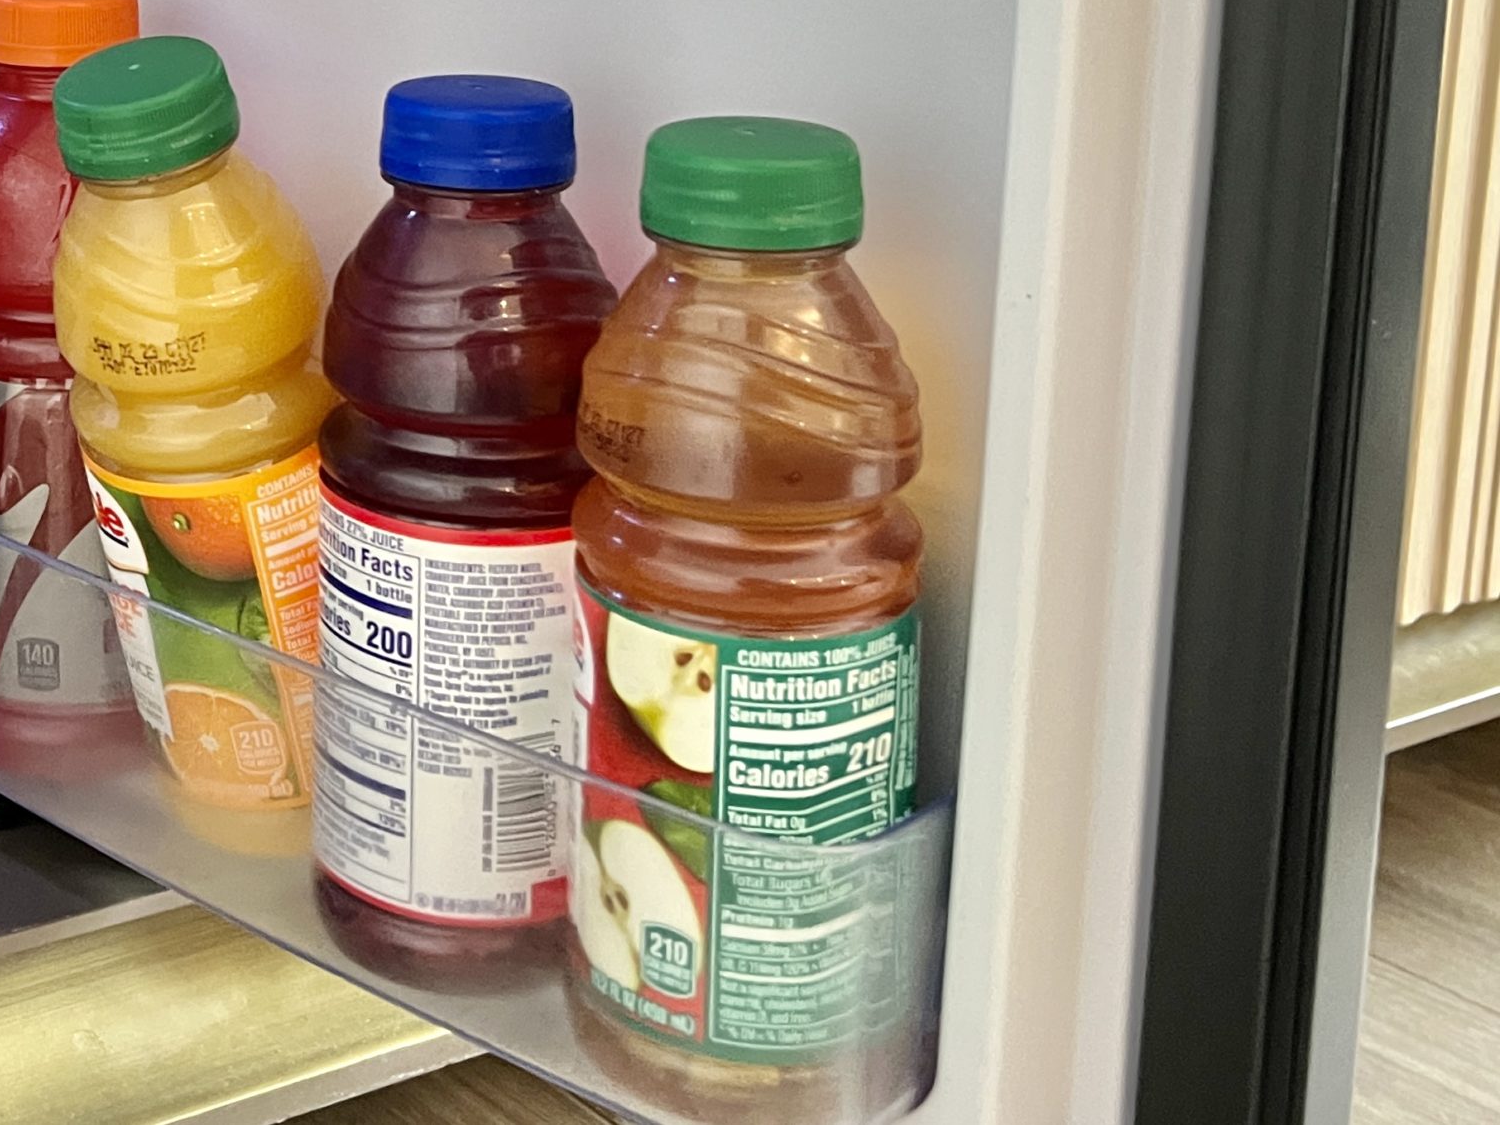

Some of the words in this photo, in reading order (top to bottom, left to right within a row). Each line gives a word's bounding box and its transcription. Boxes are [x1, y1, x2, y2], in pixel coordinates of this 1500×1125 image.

[257, 464, 314, 499] CONTAINS
[257, 482, 319, 525] Nutriti
[261, 517, 308, 544] Serving
[346, 520, 368, 540] 27%
[370, 531, 405, 552] JUICE
[361, 547, 414, 581] Facts
[366, 579, 372, 592] 1
[375, 581, 413, 604] bottle
[21, 644, 54, 665] 140
[366, 620, 413, 660] 200
[737, 649, 820, 668] CONTAINS
[824, 646, 862, 666] 100%
[865, 632, 897, 657] JUICE
[730, 673, 842, 702] Nutrition
[847, 660, 897, 693] Facts
[729, 706, 793, 729] Serving
[796, 709, 827, 725] size
[852, 700, 859, 714] 1
[861, 689, 896, 712] bottle
[239, 728, 274, 749] 210
[729, 744, 781, 761] Amount
[783, 749, 805, 764] per
[728, 760, 830, 789] Calories
[846, 732, 892, 773] 210
[728, 811, 762, 826] Total
[765, 814, 788, 826] Fat
[790, 817, 806, 830] 0g
[732, 872, 764, 889] Total
[768, 876, 812, 894] Sugars
[721, 909, 775, 927] Protein
[649, 932, 689, 966] 210
